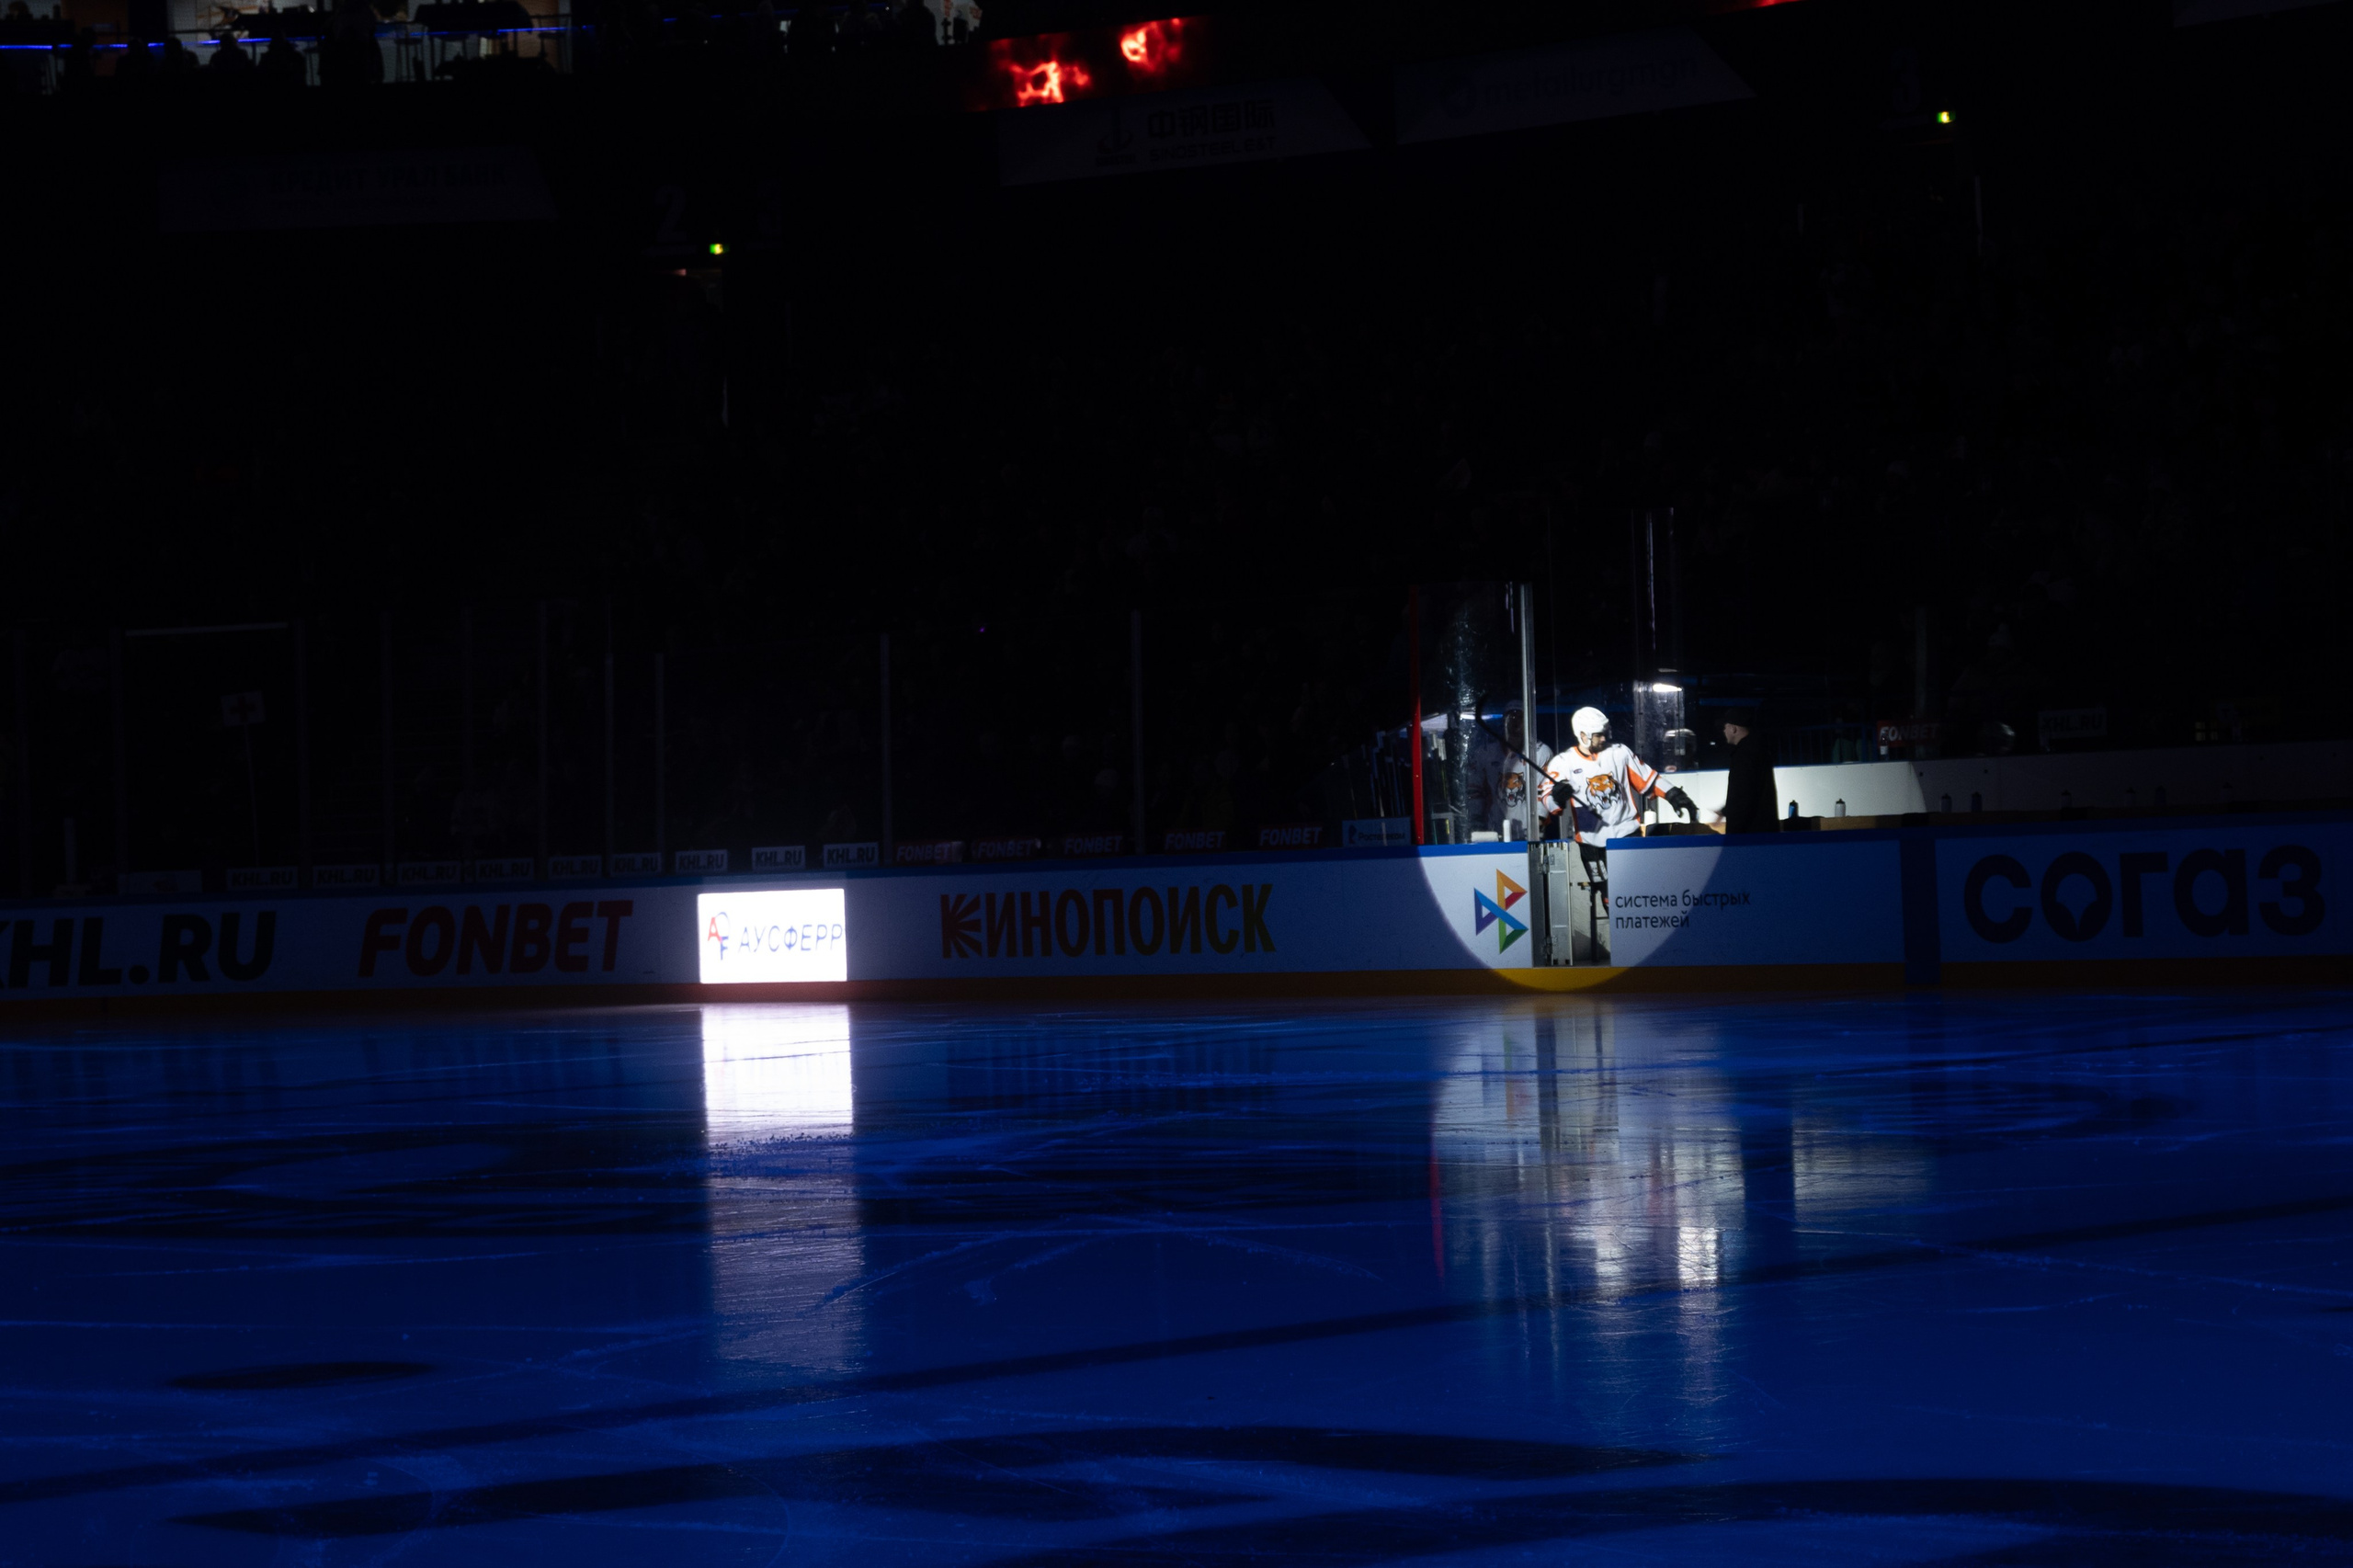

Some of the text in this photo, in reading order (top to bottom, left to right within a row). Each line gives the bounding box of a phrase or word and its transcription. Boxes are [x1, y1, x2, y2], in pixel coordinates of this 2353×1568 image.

[1148, 98, 1275, 140] 中钢国际
[1149, 142, 1241, 162] SINOSTEEL
[1244, 136, 1277, 153] E&T
[269, 164, 506, 196] КРЕДИТ УРАЛ БАНК
[1063, 835, 1122, 855] FONBET
[1165, 831, 1225, 850] FONBET
[1259, 826, 1323, 846] FONBET
[826, 846, 876, 864] KHL.RU
[896, 843, 951, 862] FONBET
[976, 839, 1034, 858] FONBET
[551, 860, 599, 876] KHL.RU
[613, 857, 658, 873] KHL.RU
[678, 855, 724, 870] KHL.RU
[755, 850, 802, 867] KHL.RU
[232, 871, 293, 887] KHL.RU
[316, 869, 375, 884] KHL.RU
[401, 866, 457, 881] KHL.RU
[478, 862, 530, 878] KHL.RU
[1615, 889, 1751, 911] система быстрых
[940, 883, 1277, 959] КИНОПОИСК
[1615, 910, 1690, 929] платежей
[358, 900, 633, 978] FONBET
[738, 923, 843, 953] АУСФЕРР
